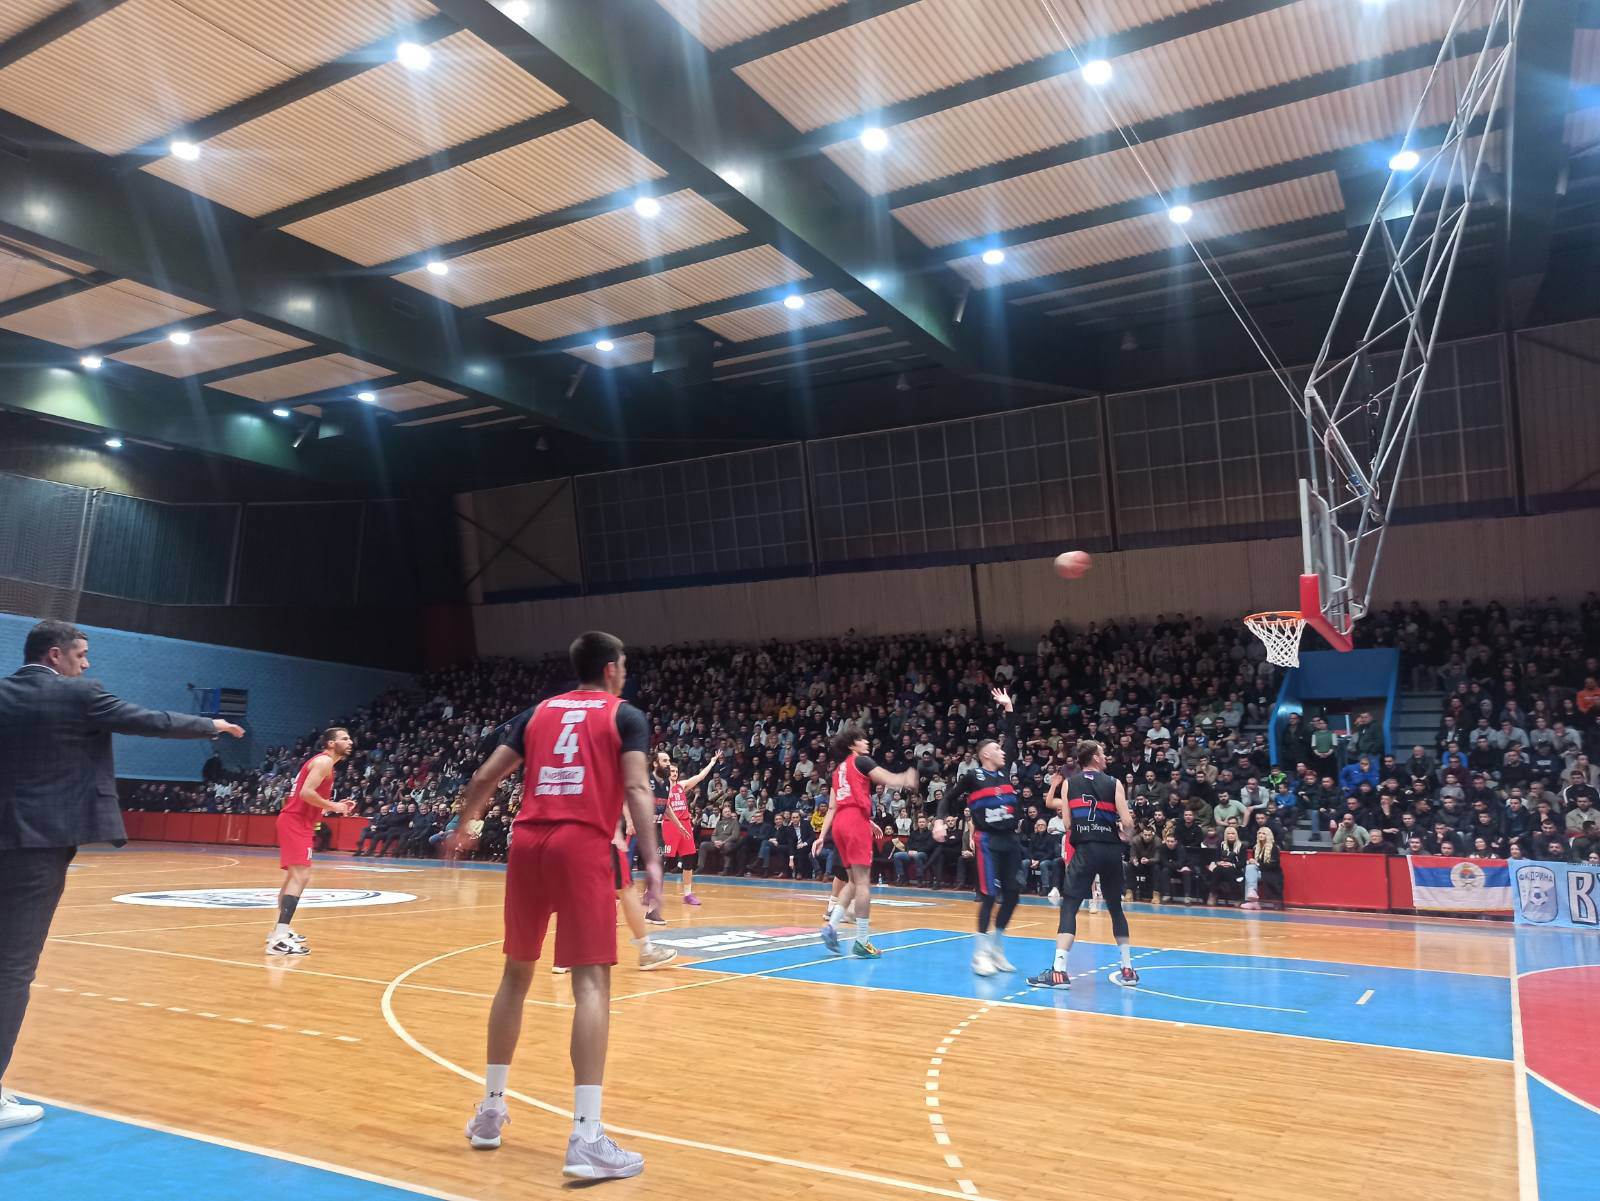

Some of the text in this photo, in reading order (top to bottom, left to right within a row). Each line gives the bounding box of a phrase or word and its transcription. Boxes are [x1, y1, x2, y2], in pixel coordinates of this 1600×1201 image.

[553, 724, 580, 763] 4
[1081, 793, 1098, 822] 7
[1567, 870, 1600, 926] В
